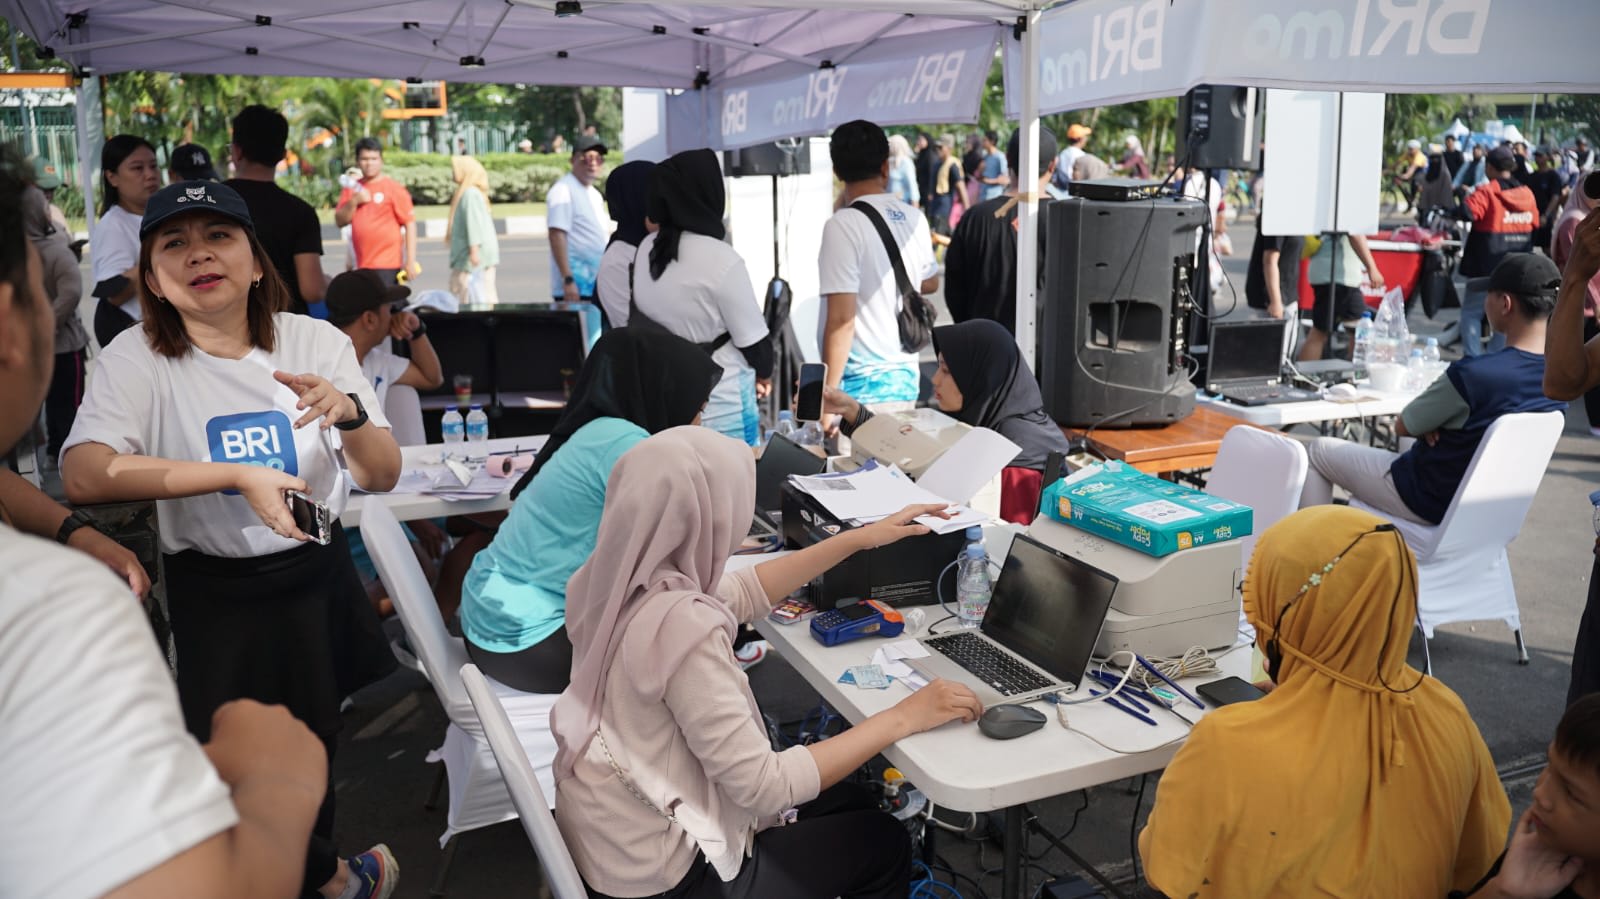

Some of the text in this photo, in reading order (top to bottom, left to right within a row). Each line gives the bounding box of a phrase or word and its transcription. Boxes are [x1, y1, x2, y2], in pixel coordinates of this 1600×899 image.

[221, 425, 281, 459] BRI
[1130, 525, 1151, 540] Paper
[1132, 531, 1151, 547] Copy
